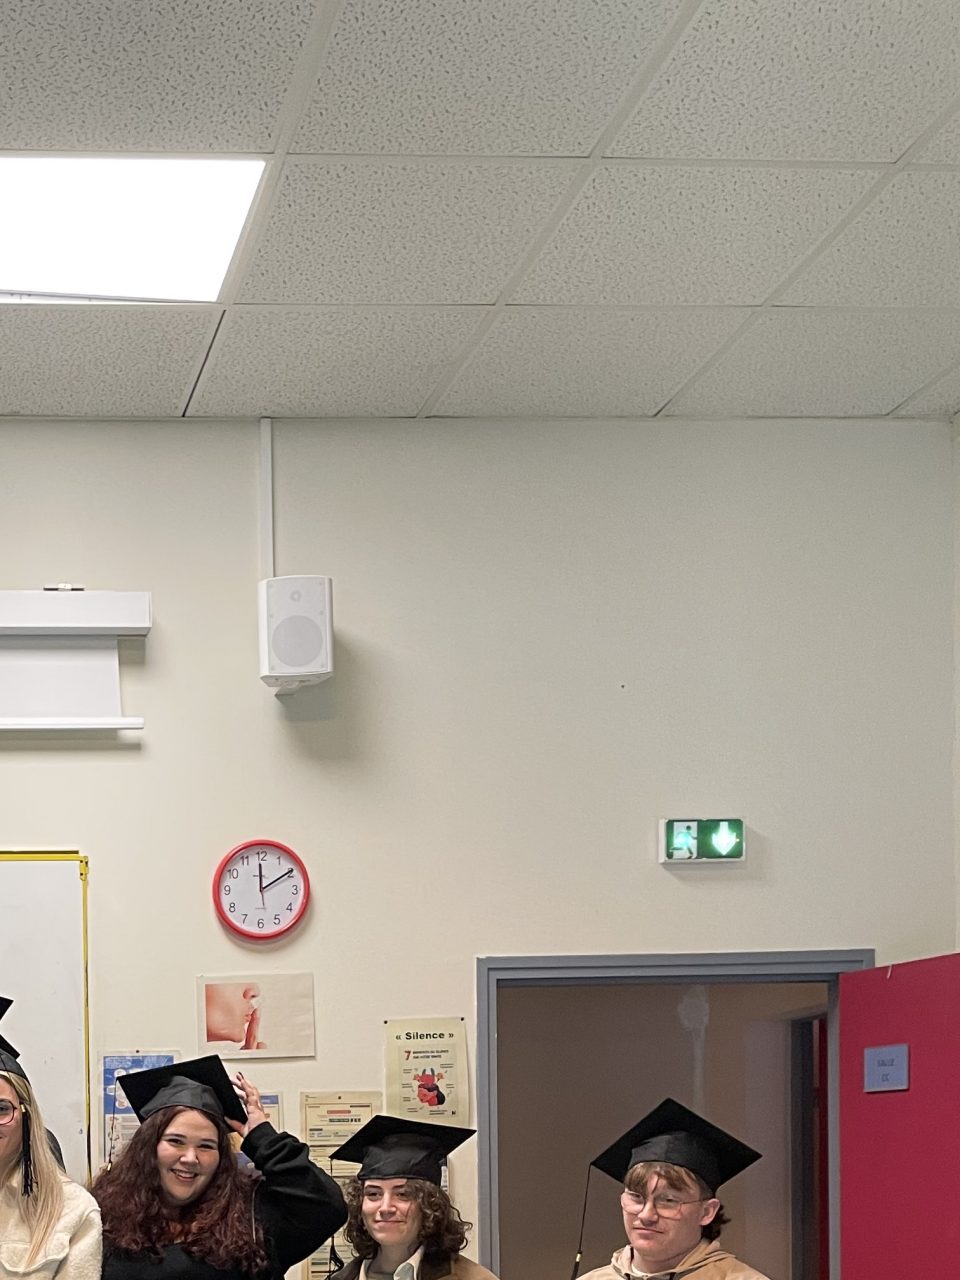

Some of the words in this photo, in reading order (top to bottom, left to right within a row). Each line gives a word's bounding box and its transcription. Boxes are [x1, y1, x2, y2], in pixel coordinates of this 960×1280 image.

[240, 855, 250, 866] 11
[255, 850, 268, 861] 12
[276, 855, 281, 865] 1
[227, 868, 239, 879] 10
[223, 884, 231, 895] 9
[291, 884, 299, 895] 3
[228, 902, 236, 912] 8
[285, 902, 293, 912] 4
[241, 913, 248, 924] 7
[257, 918, 265, 929] 6
[273, 913, 281, 925] 5
[405, 1032, 445, 1040] Silence
[404, 1050, 411, 1060] 7
